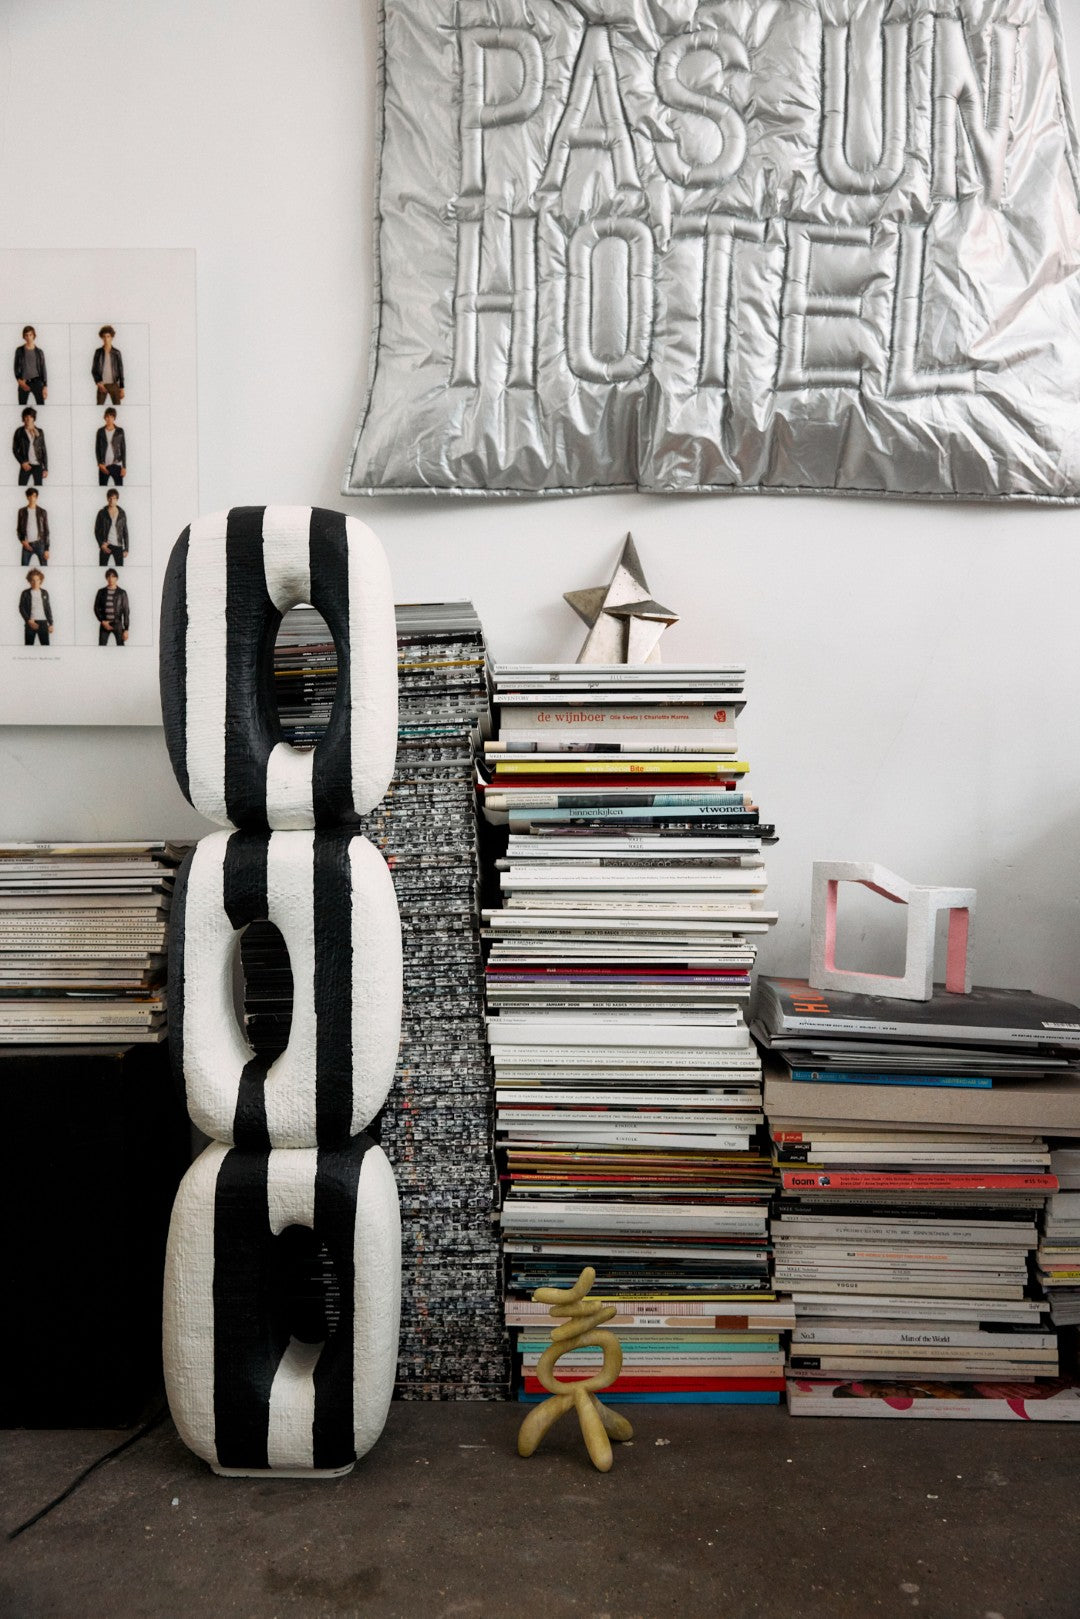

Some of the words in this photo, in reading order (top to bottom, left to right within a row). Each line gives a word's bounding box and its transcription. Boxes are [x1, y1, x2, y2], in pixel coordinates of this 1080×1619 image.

[456, 22, 752, 198] PAS
[817, 15, 1022, 209] UN
[449, 213, 978, 400] HOTEL
[537, 712, 551, 722] de
[555, 712, 606, 724] wijnboer
[569, 808, 623, 818] binnenkijken
[699, 805, 746, 814] vtwonen
[792, 1177, 814, 1186] foam
